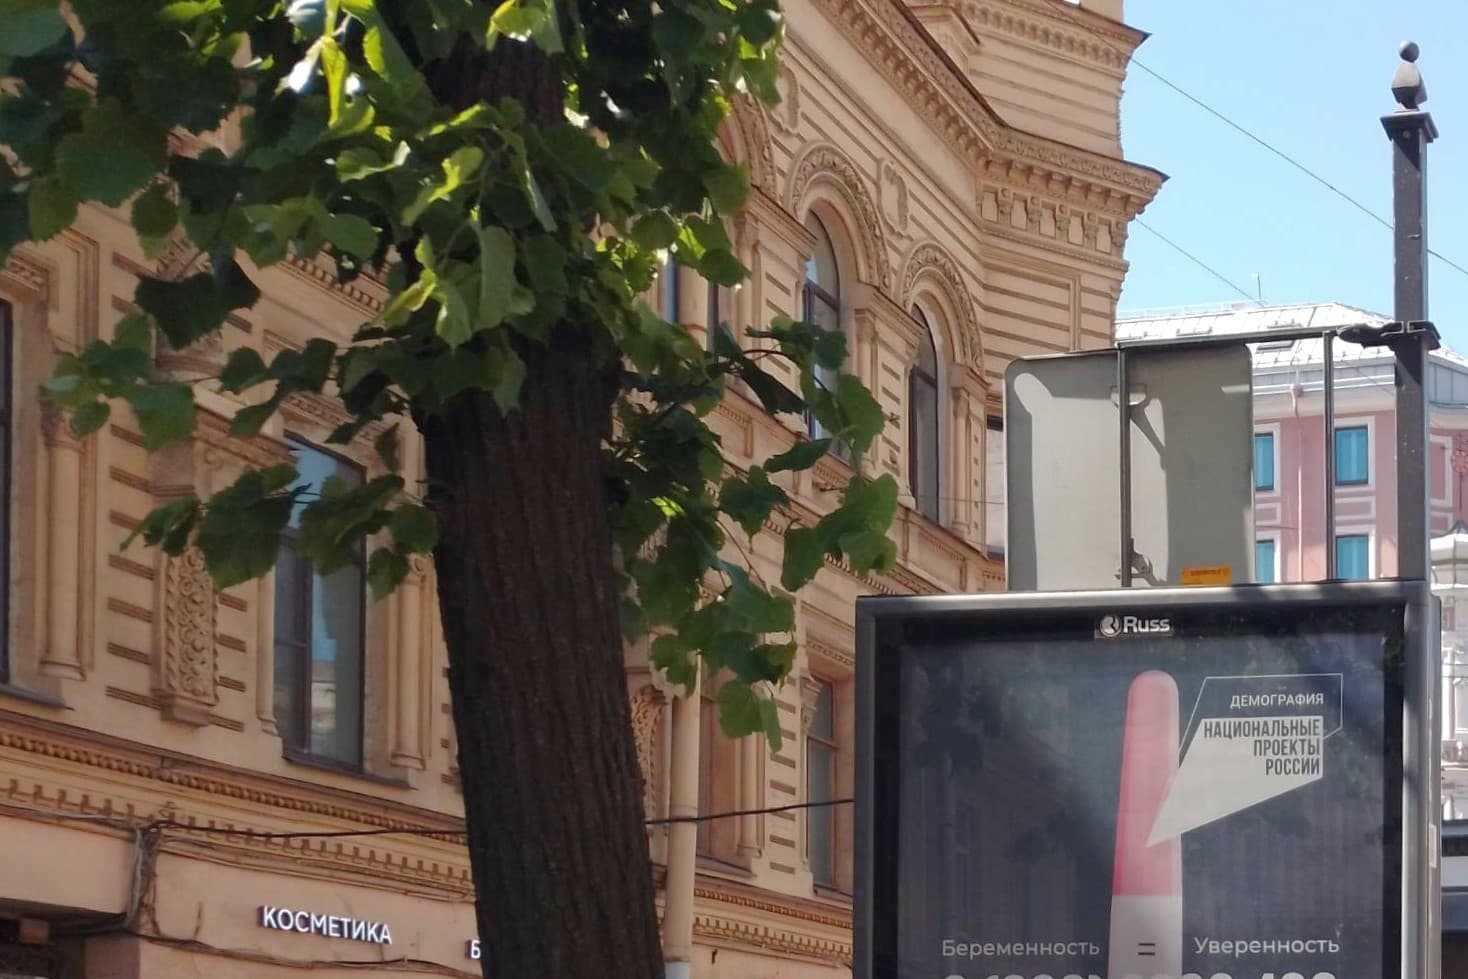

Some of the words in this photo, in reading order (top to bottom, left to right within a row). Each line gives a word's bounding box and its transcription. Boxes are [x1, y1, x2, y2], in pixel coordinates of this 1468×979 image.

[1123, 616, 1171, 633] Russ
[1230, 693, 1324, 709] ДЕМОГРАФИЯ
[1204, 719, 1320, 739] НАЦИОНАЛЬНЫЕ
[1254, 738, 1320, 756] ПРОЕКТЫ
[1265, 758, 1320, 776] РОССИИ
[262, 904, 393, 945] КОСМЕТИКА
[942, 939, 1100, 960] Беременность
[1194, 937, 1340, 958] Уверенность
